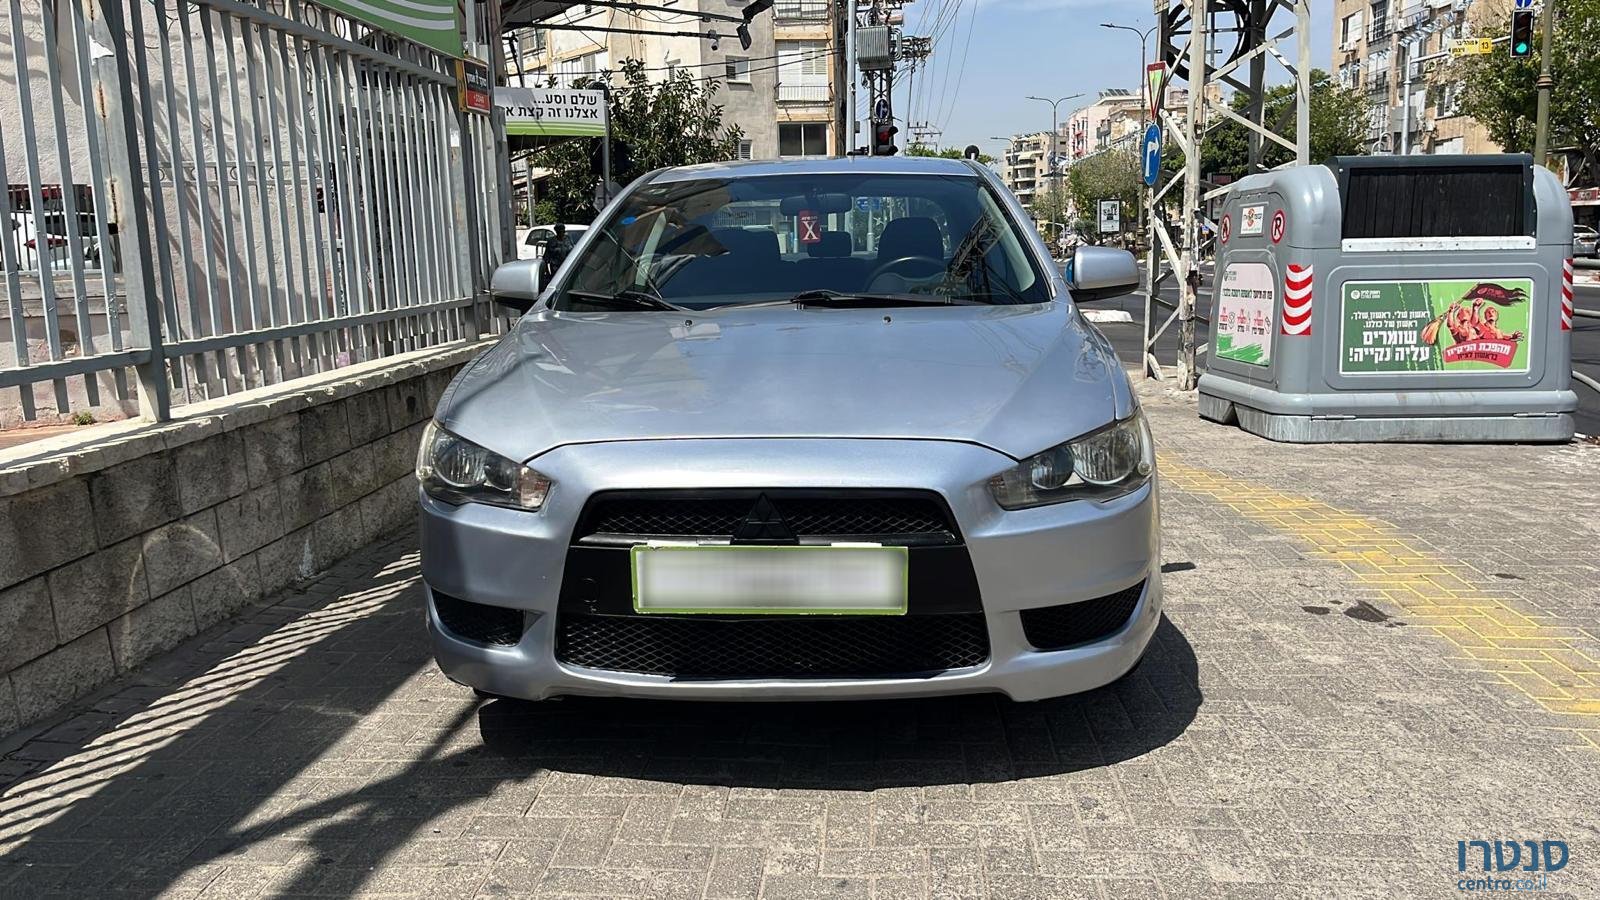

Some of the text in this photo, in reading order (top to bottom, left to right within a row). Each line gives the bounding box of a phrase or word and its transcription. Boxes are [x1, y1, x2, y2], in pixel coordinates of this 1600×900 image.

[1481, 41, 1489, 50] 13
[533, 93, 597, 106] שלם וסע...
[517, 106, 544, 120] קצת
[548, 107, 561, 118] זה
[565, 106, 598, 119] אצלנו
[802, 221, 818, 240] X
[1370, 311, 1391, 320] ראשון
[1409, 310, 1430, 320] ראשון
[1384, 319, 1395, 328] של
[1396, 320, 1418, 329] ראשון
[1362, 330, 1417, 345] שומרים
[1348, 344, 1430, 364] עליה נקייה!
[1478, 342, 1511, 355] מהפכת
